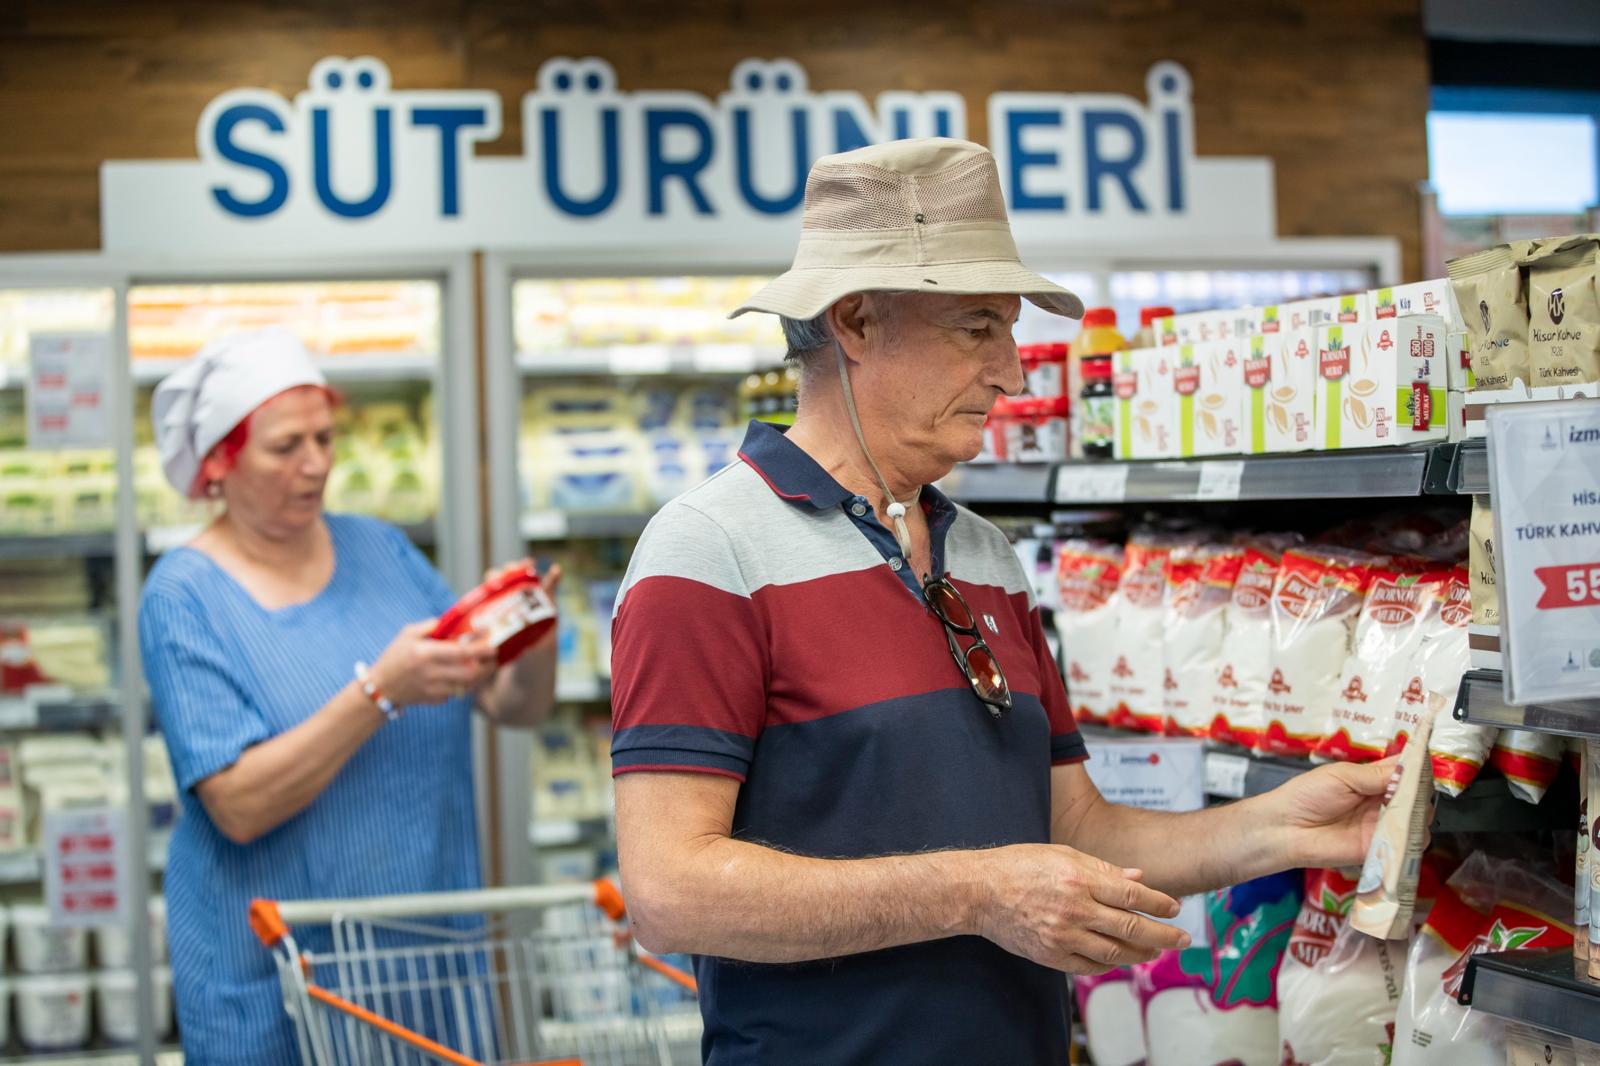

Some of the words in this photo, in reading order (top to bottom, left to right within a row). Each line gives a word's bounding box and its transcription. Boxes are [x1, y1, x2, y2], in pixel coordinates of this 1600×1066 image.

[211, 70, 486, 218] SÜT
[541, 71, 1184, 216] ÜRÜERİ
[1516, 522, 1556, 541] TÜRK
